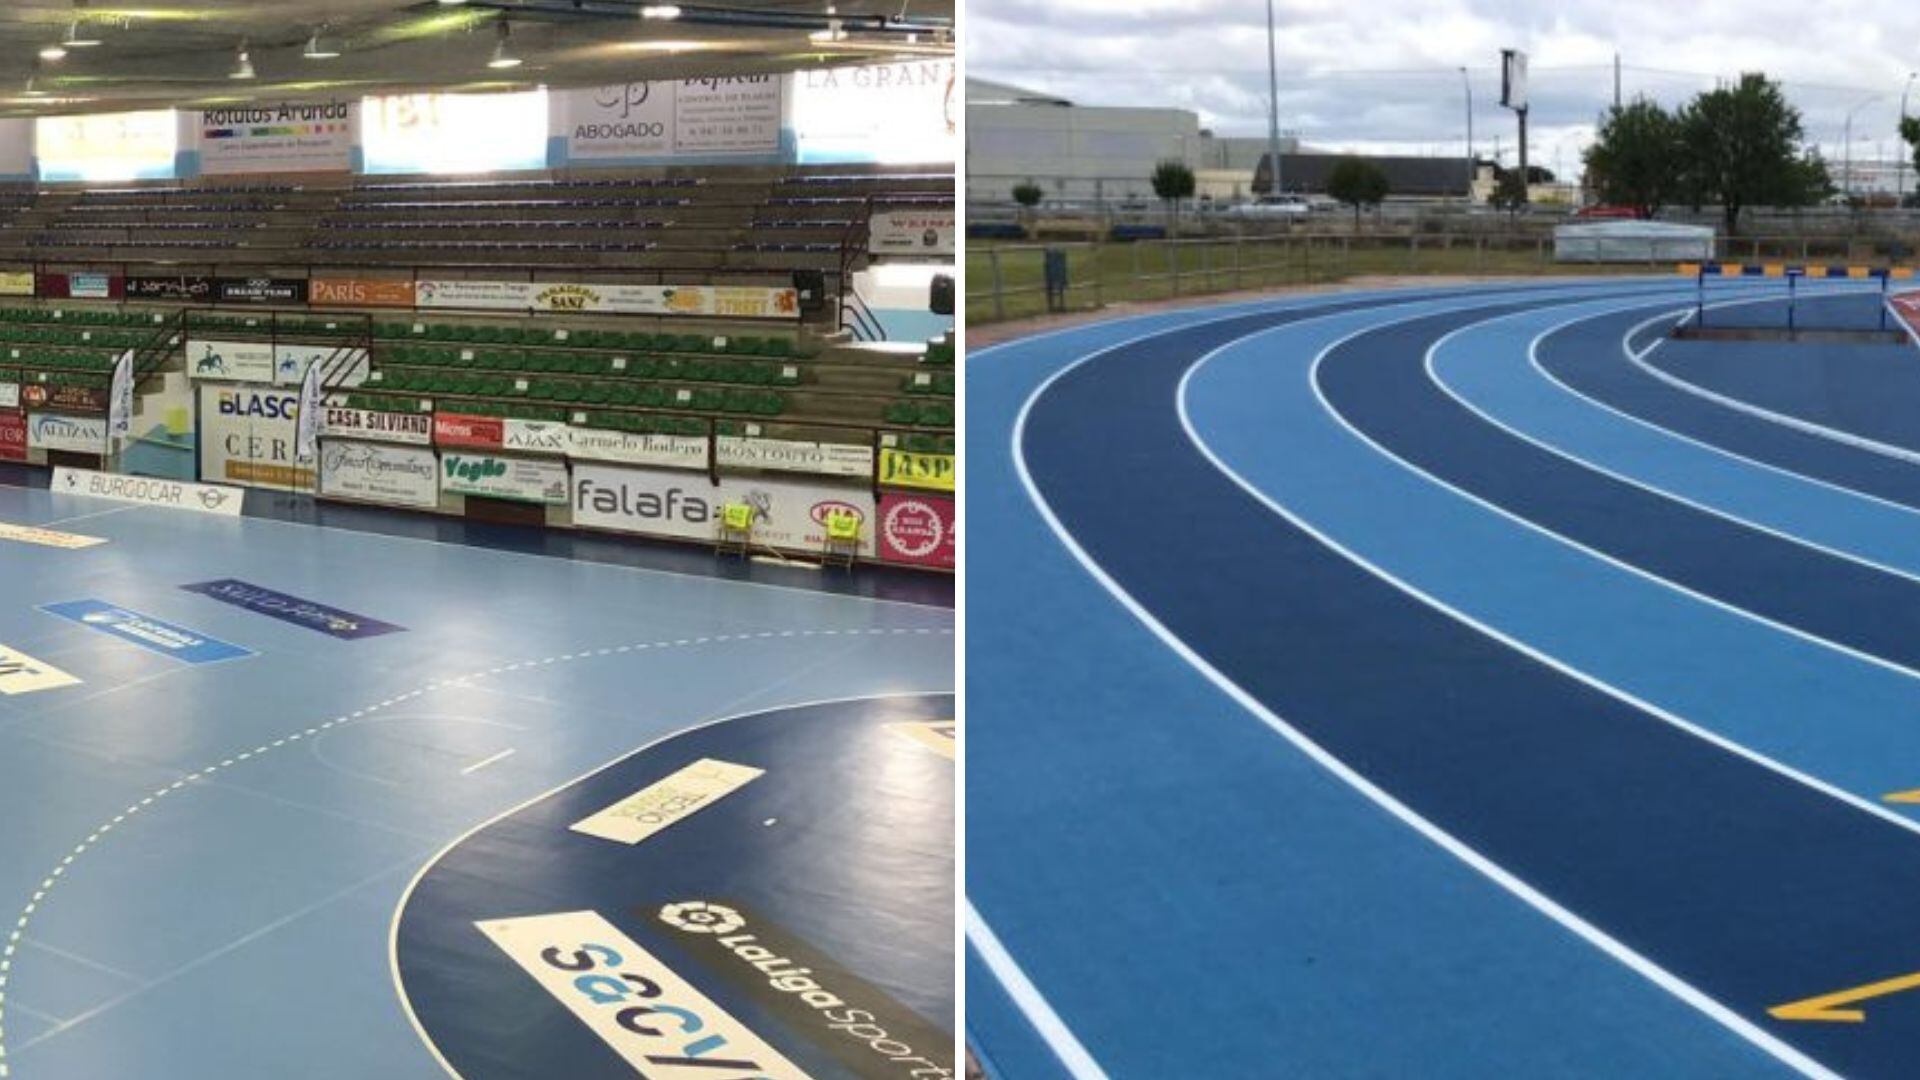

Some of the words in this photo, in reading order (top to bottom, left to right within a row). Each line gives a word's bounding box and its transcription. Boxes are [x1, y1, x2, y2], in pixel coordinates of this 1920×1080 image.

[853, 62, 956, 88] GRAN
[575, 122, 664, 140] ABOGADO
[327, 410, 361, 428] CASA
[366, 411, 429, 434] SILVIANO
[89, 474, 182, 504] BURGOCAR
[577, 478, 723, 523] falafa
[541, 942, 775, 1080] sacy
